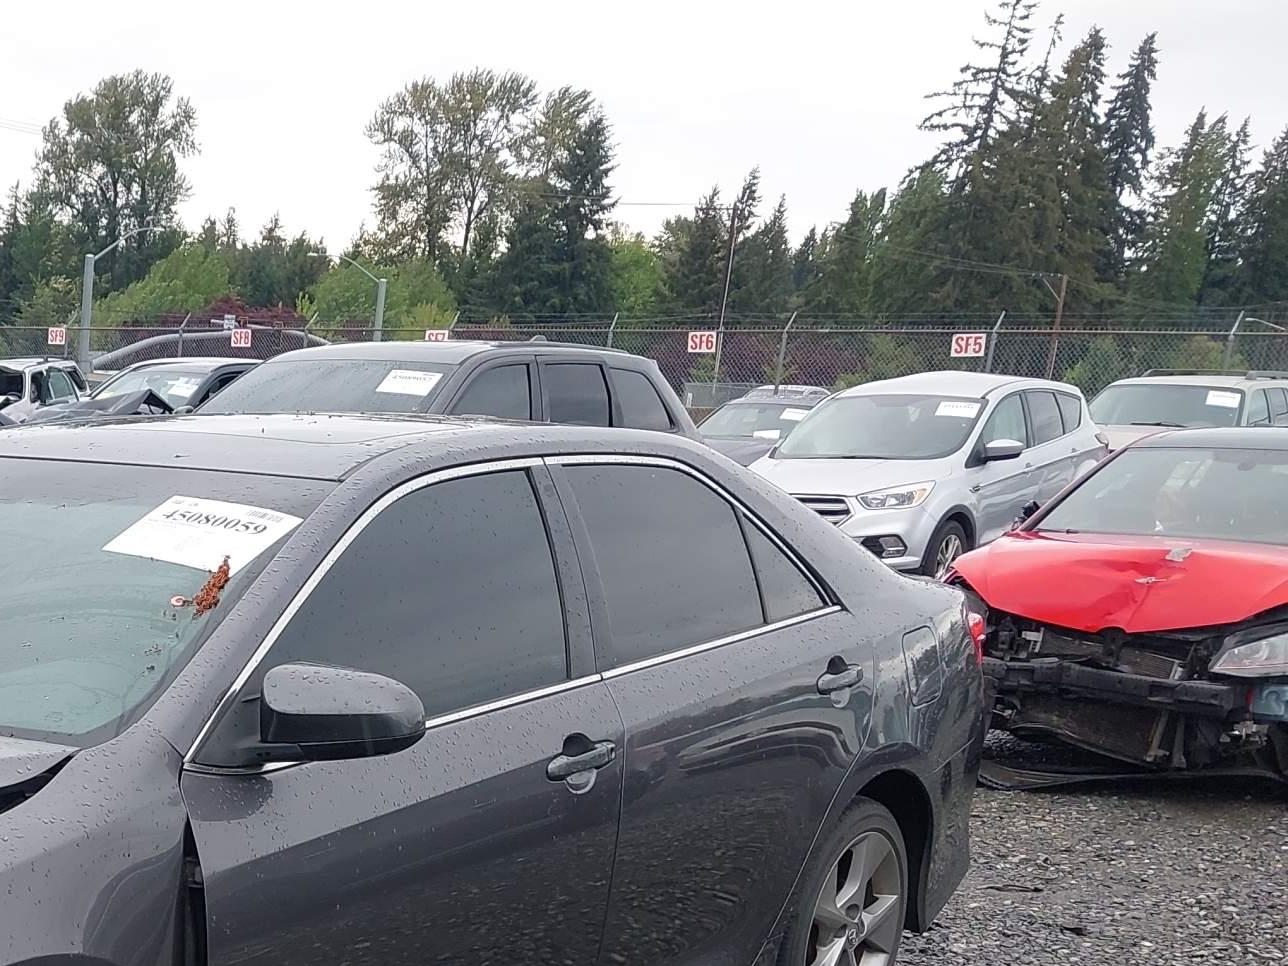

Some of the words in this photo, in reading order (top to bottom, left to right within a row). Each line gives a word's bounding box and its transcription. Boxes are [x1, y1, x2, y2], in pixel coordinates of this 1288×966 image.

[49, 329, 64, 343] SF9
[233, 330, 250, 345] SF8
[690, 333, 714, 350] SF6
[954, 335, 983, 354] SF5
[162, 509, 268, 535] 45080059
